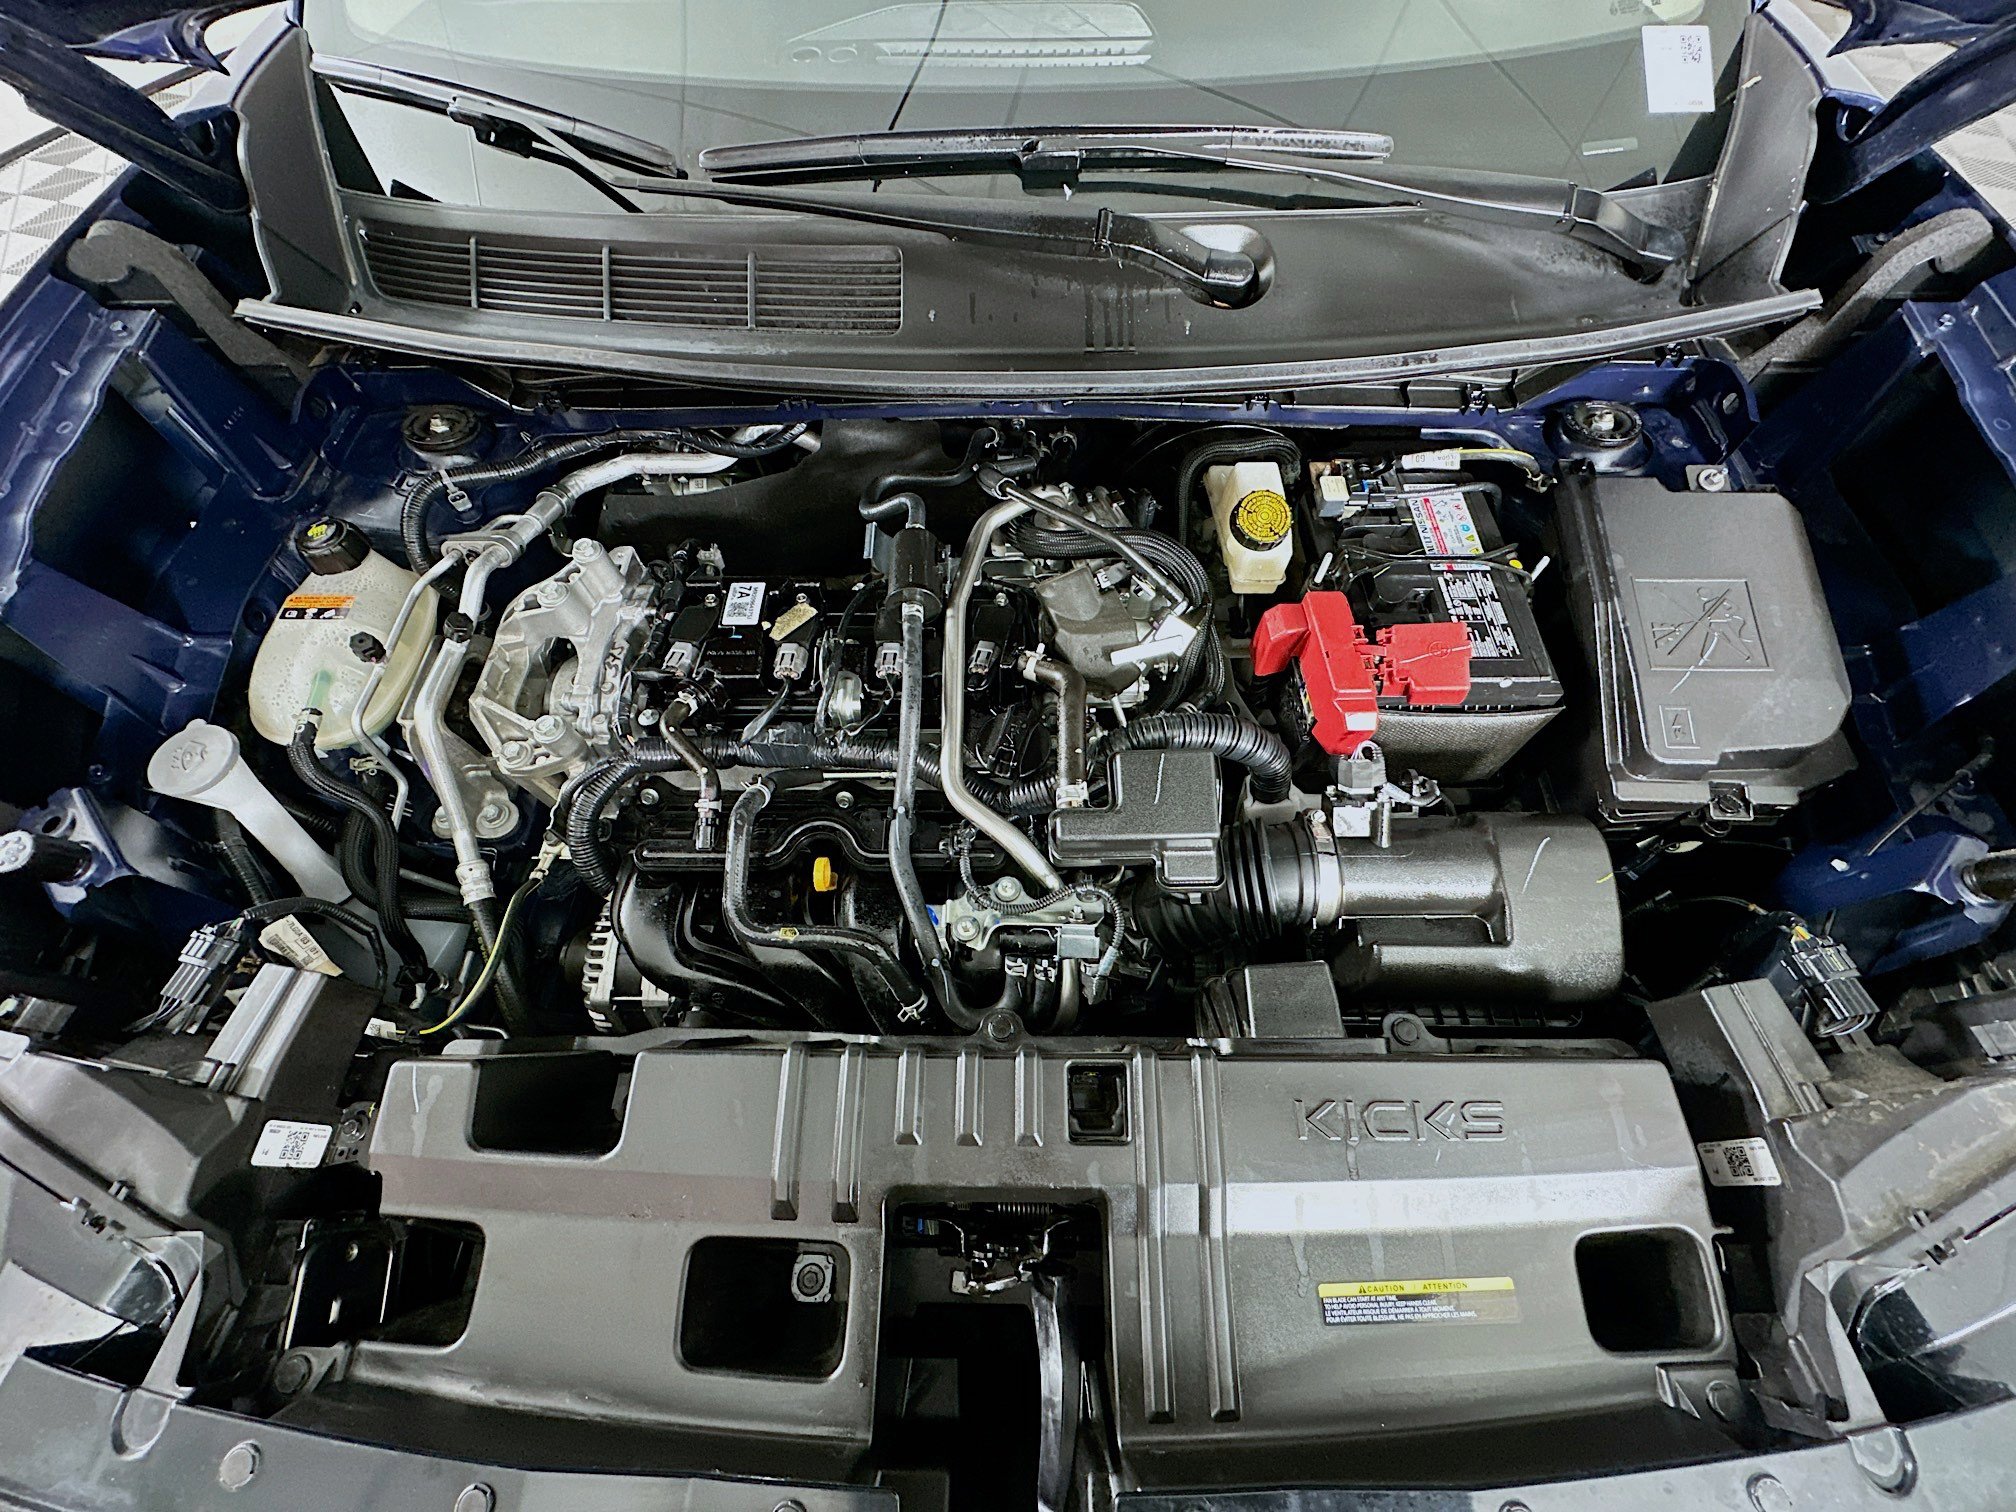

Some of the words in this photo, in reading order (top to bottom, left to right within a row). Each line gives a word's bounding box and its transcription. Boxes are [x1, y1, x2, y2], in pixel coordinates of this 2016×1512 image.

[1411, 499, 1428, 534] NISSAN
[737, 585, 753, 599] 7A
[1294, 1099, 1508, 1142] KICKS
[1367, 1284, 1405, 1293] CAUTION
[1422, 1282, 1468, 1291] ATTENTION
